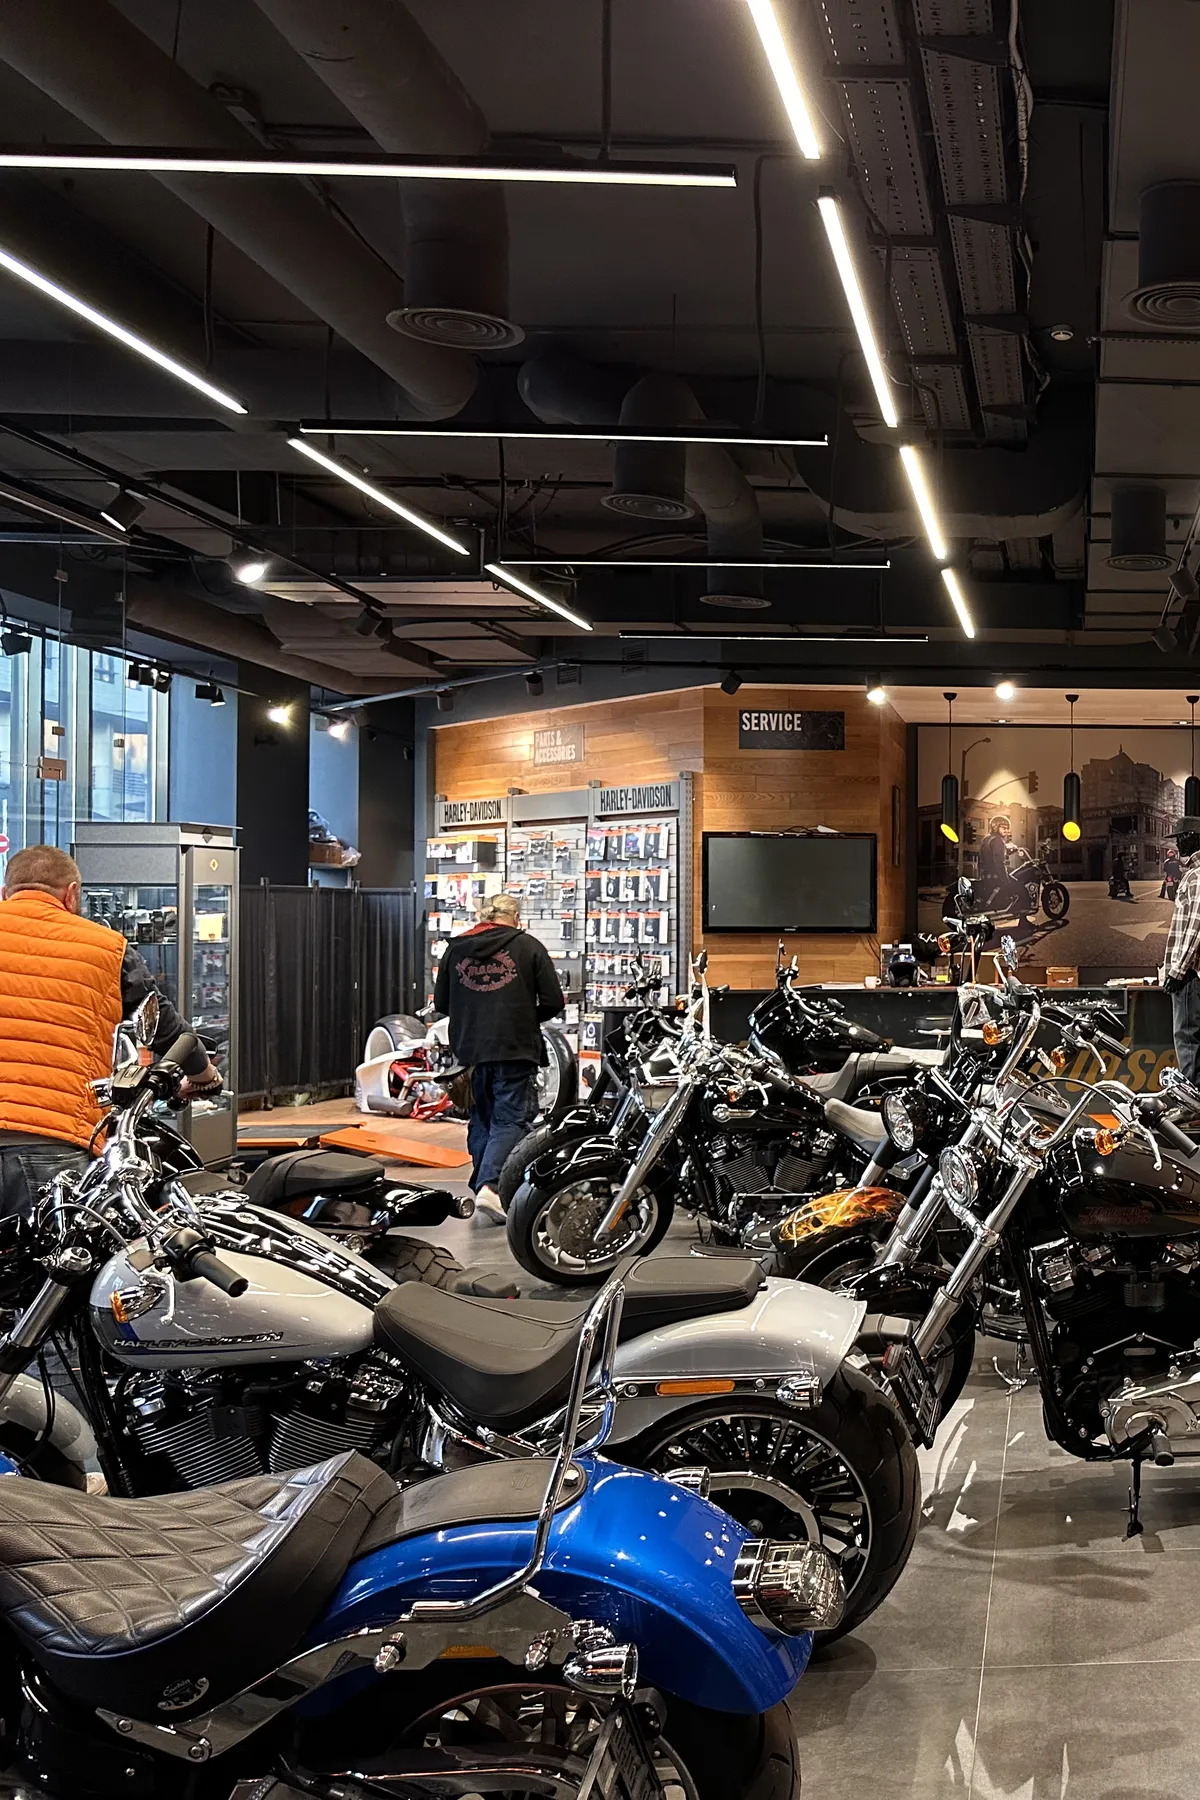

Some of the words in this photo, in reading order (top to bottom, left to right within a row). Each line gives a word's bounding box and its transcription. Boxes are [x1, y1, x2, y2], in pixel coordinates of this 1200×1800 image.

[741, 712, 802, 732] SERVICE
[535, 731, 555, 746] PARTS
[555, 729, 562, 745] &
[534, 744, 576, 764] ACCESSORIES
[600, 785, 672, 811] HARLEY-DAVIDSON
[444, 800, 502, 823] HARLEY-DAVIDSON
